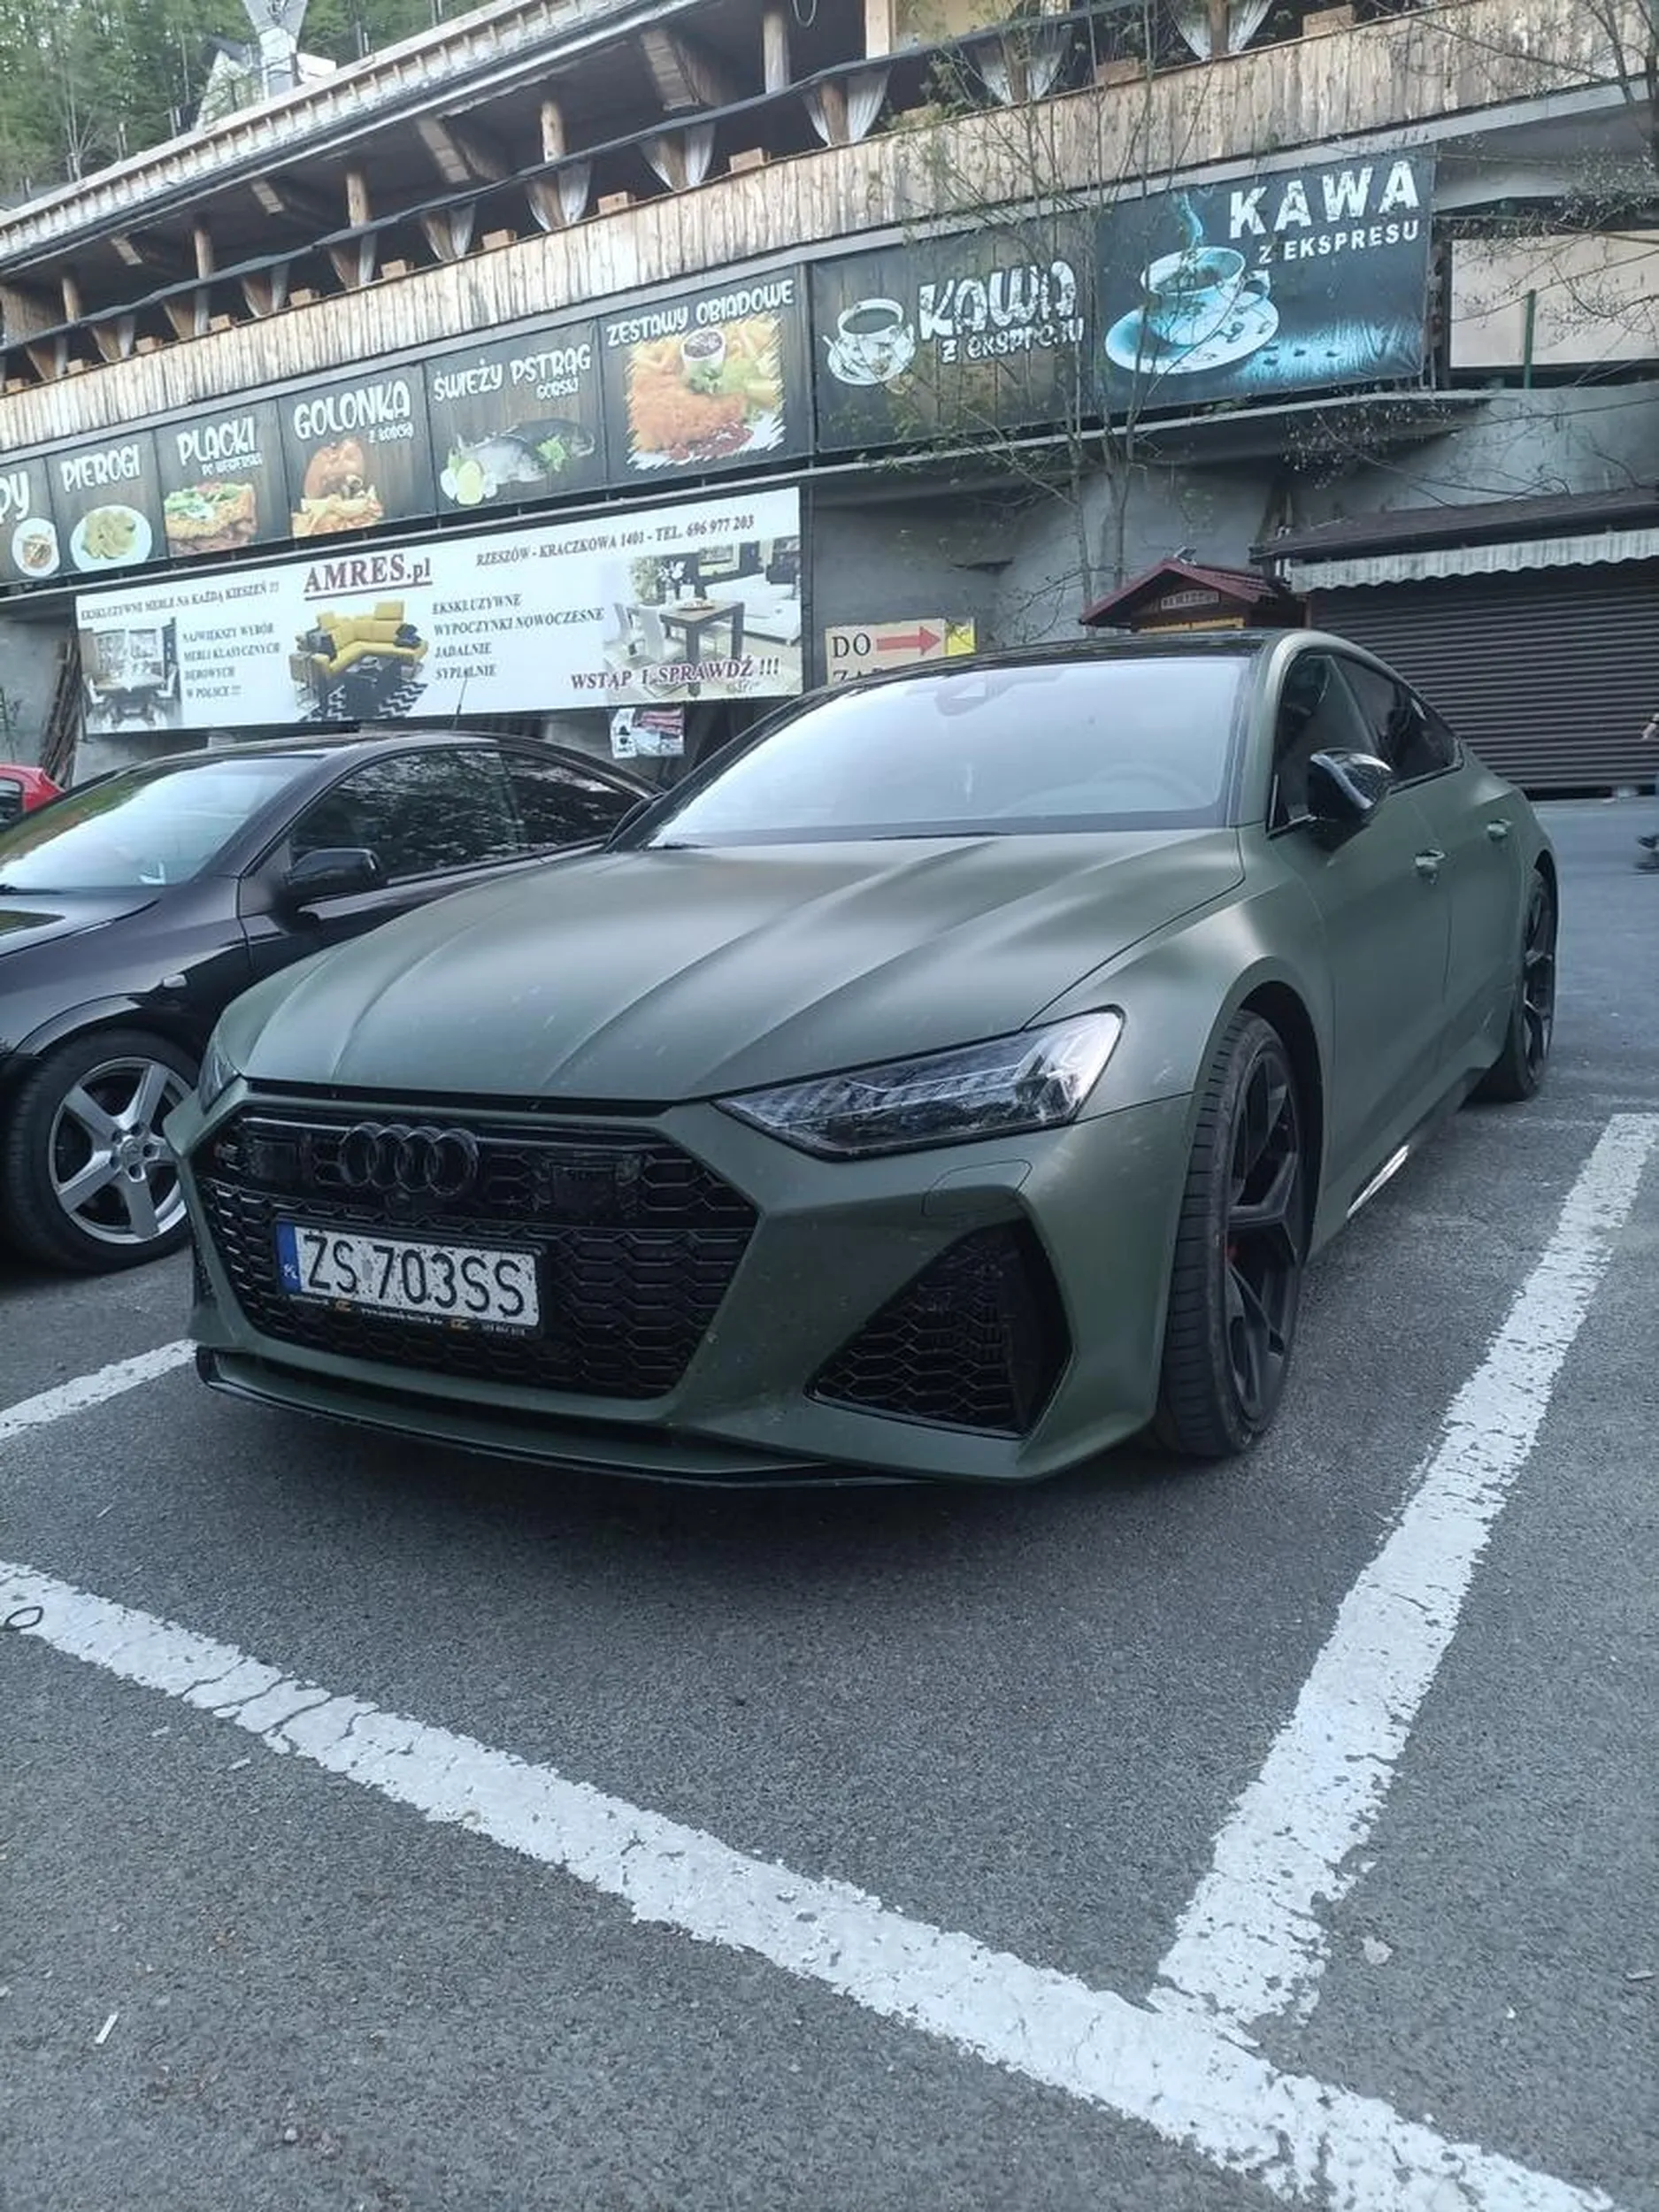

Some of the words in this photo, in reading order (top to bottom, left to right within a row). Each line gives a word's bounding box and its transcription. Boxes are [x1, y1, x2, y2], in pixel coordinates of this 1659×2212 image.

[1228, 160, 1420, 239] KAWA
[1259, 242, 1276, 265] Z
[1283, 220, 1420, 262] EKSPRESU
[606, 304, 689, 348] ZESTAWY
[695, 279, 795, 326] OBIADOWE
[918, 260, 1077, 341] KAWA
[434, 357, 503, 402] ŚWIEŻY
[510, 343, 591, 385] PSTRĄG
[294, 380, 411, 440] GOLONKA
[177, 417, 256, 465] PLACKI
[60, 444, 141, 492] PIEROGI
[476, 547, 532, 566] RZESZÓW
[539, 536, 617, 559] KRACZKOWA
[656, 525, 683, 542] TEL.
[687, 520, 707, 539] 696
[709, 519, 731, 536] 977
[733, 514, 754, 532] 203
[303, 553, 431, 593] AMRES.pl
[434, 618, 513, 636] WYPOCZYNKI
[514, 607, 605, 629] NOWOCZESNE
[832, 632, 872, 658] DO
[571, 670, 633, 691] WSTĄP
[657, 656, 754, 684] SPRAWDŹ
[759, 657, 780, 676] !!!
[304, 1233, 357, 1294] ZS
[373, 1244, 526, 1317] 703SS
